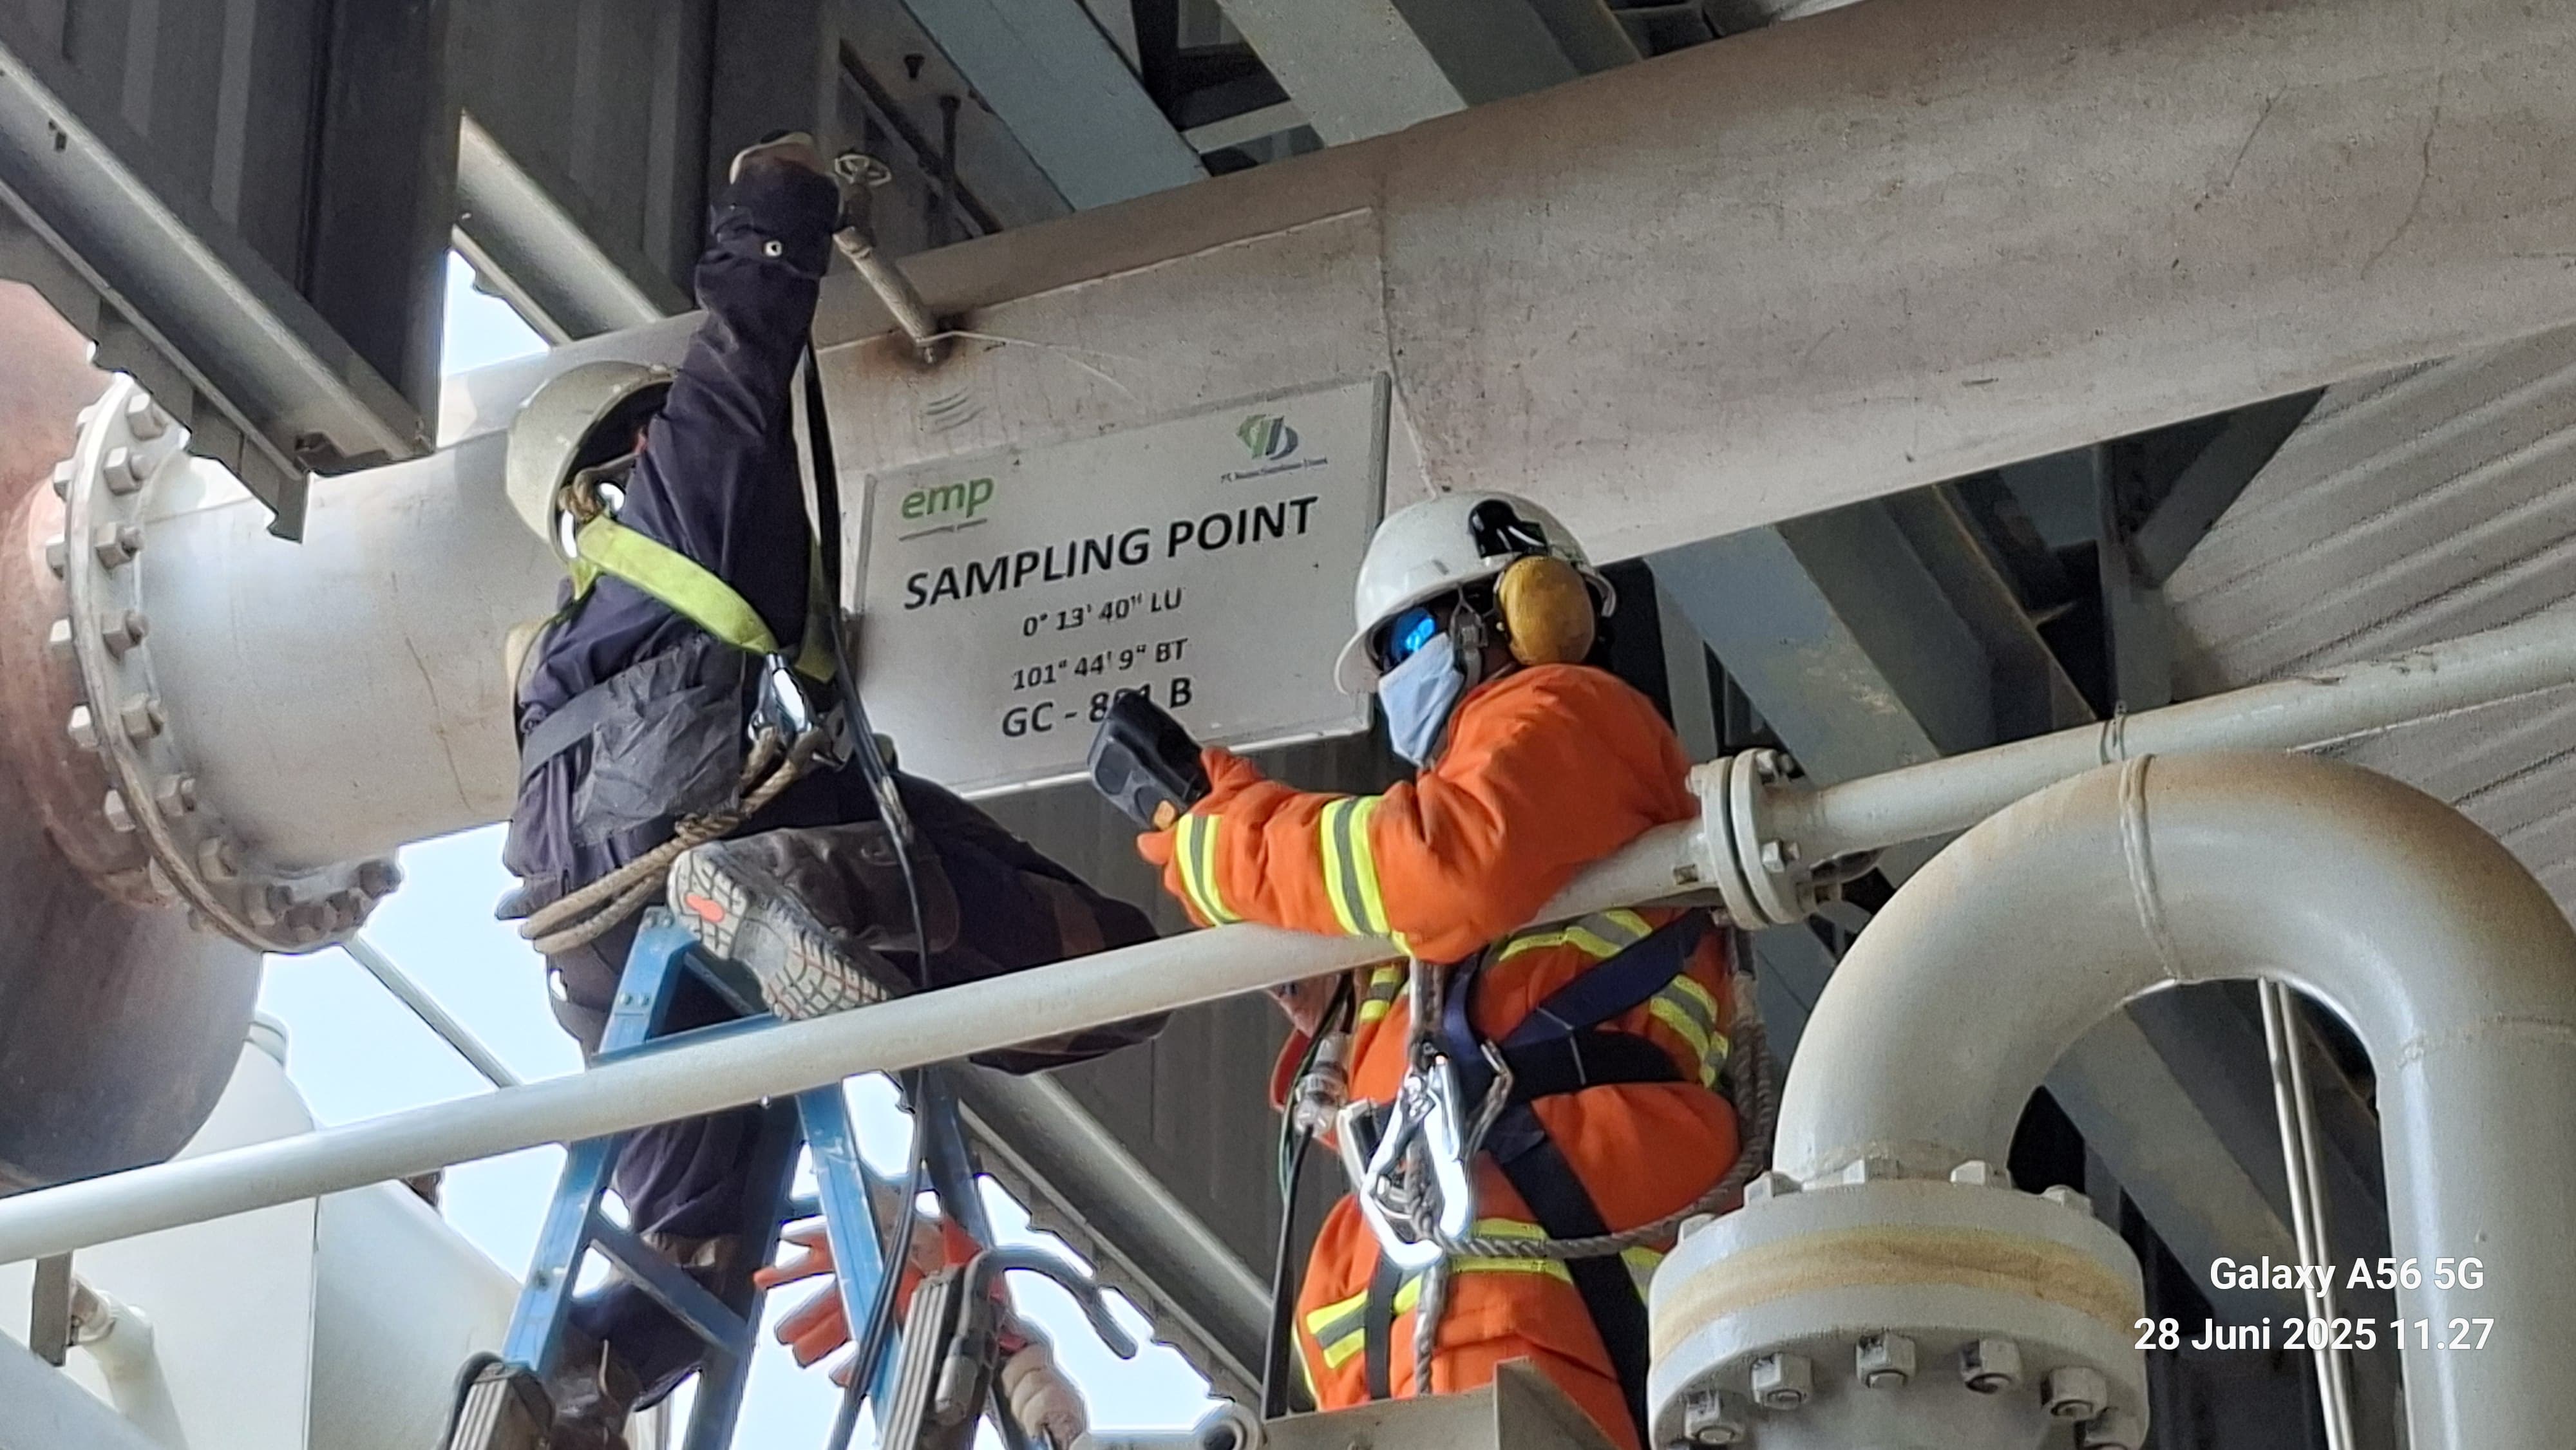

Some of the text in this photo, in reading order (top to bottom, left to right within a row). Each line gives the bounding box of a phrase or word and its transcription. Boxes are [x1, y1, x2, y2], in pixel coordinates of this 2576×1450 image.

[902, 478, 994, 519] emp
[904, 495, 1318, 610] SAMPLING POINT
[1151, 587, 1182, 612] LU
[1155, 637, 1188, 663] BT
[1002, 702, 1054, 737] GC
[1170, 677, 1191, 708] B
